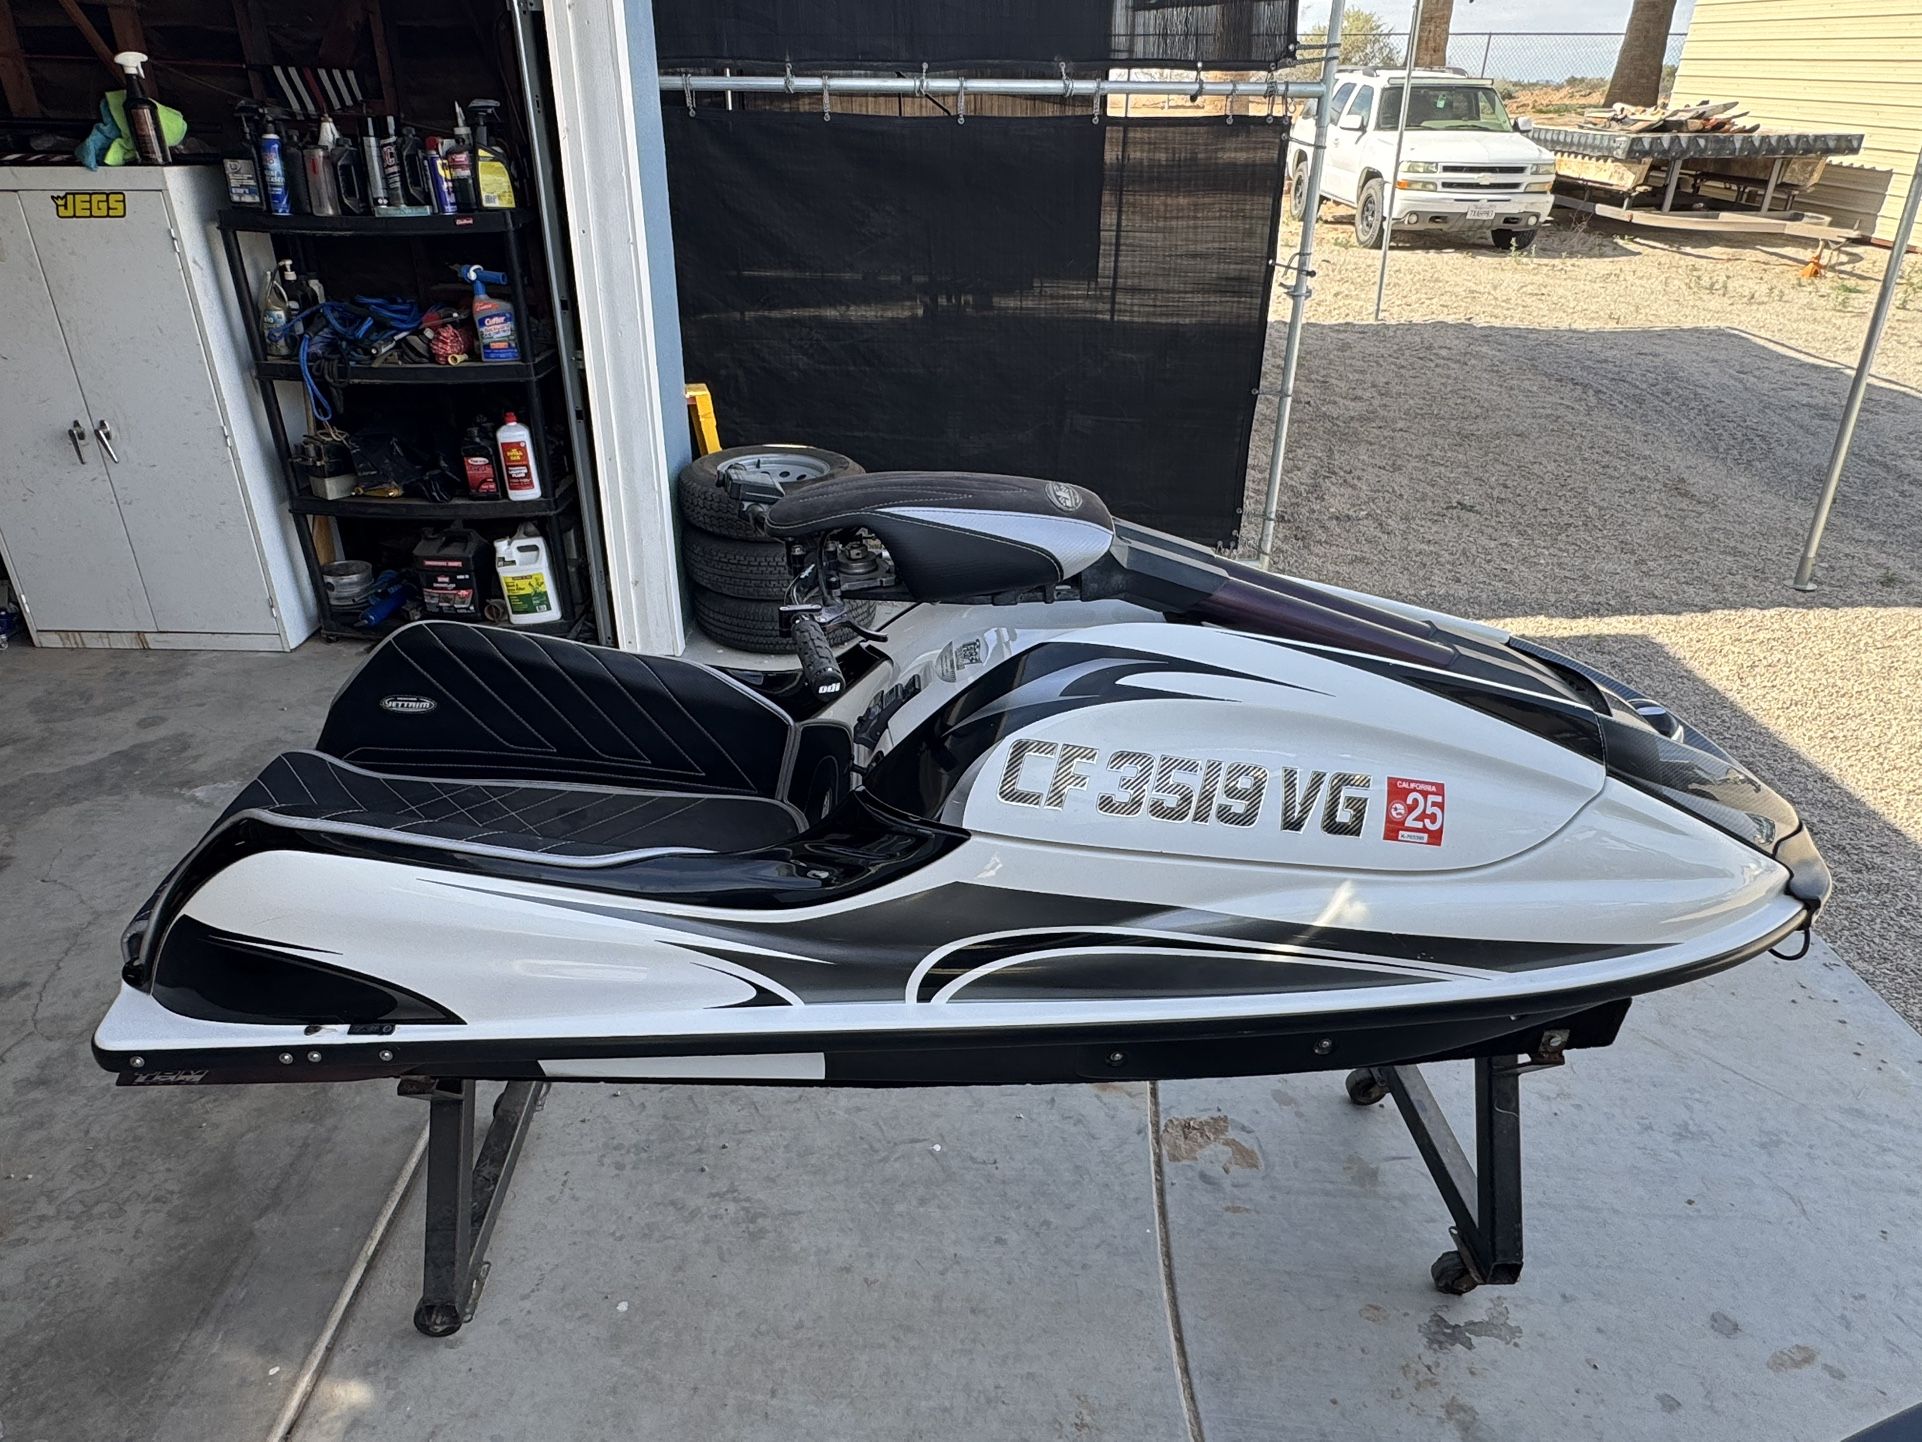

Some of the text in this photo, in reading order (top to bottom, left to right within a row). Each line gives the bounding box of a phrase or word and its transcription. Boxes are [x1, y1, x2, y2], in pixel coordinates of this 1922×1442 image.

[57, 192, 126, 218] JEGS
[818, 682, 841, 694] odi
[996, 738, 1373, 839] CF 3519 VG
[1396, 780, 1437, 792] CALIFORNIA
[1404, 791, 1443, 831] 25
